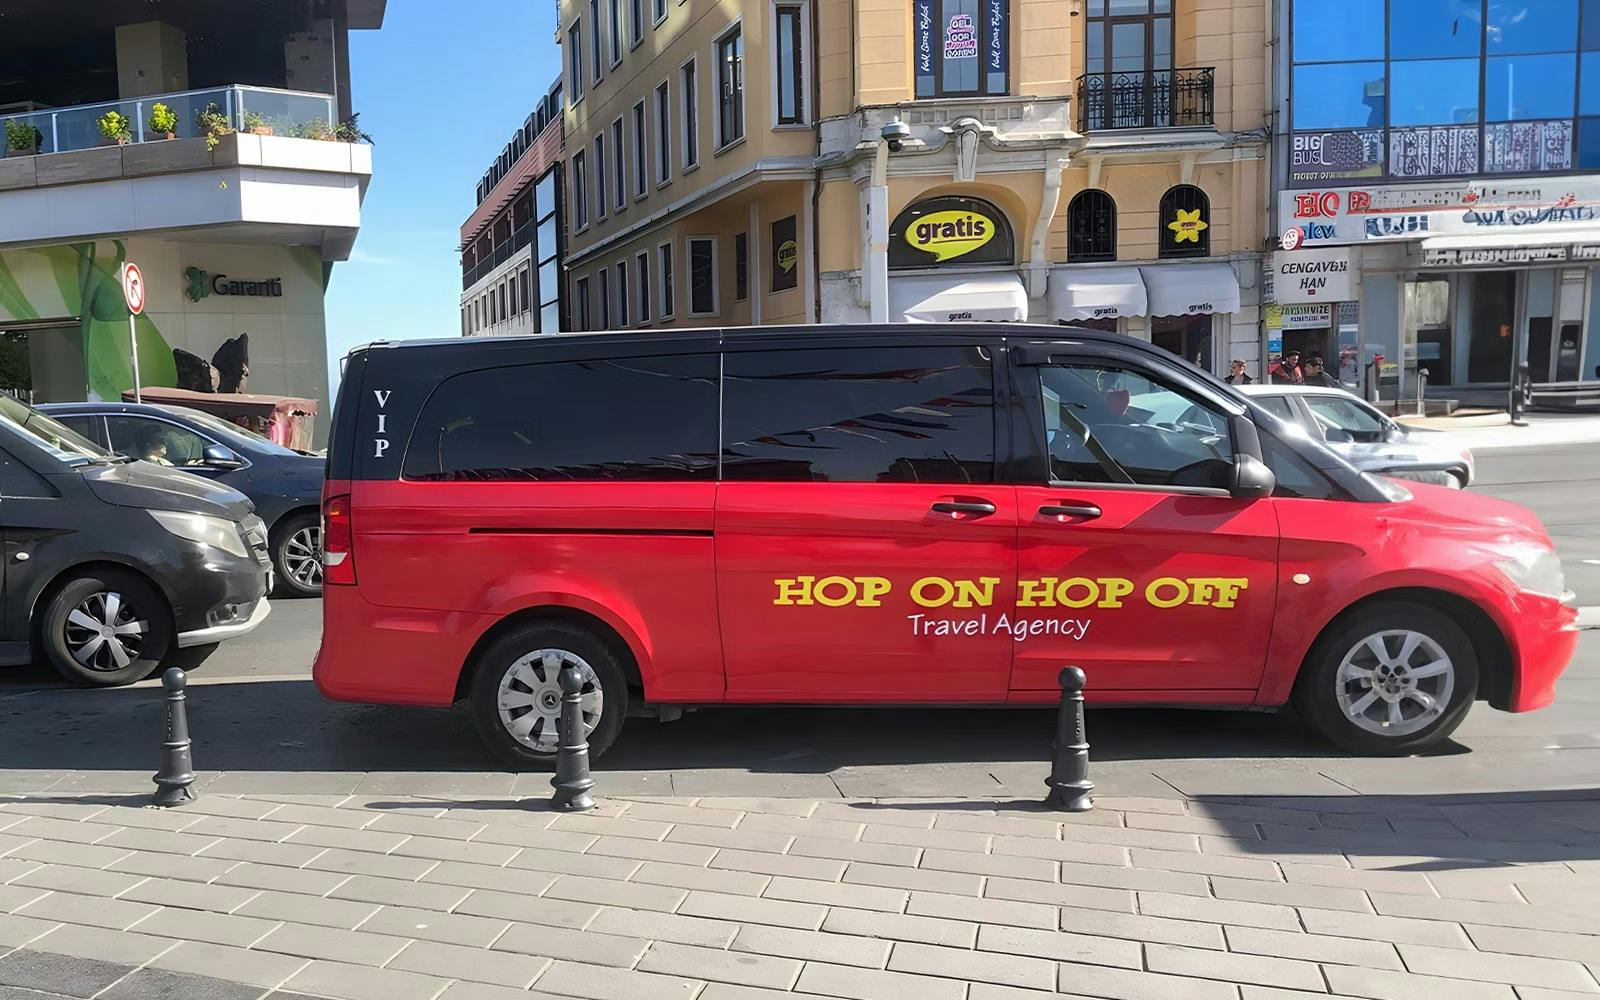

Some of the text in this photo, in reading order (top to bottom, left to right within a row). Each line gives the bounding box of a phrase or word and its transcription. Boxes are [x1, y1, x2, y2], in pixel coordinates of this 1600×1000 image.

[1294, 136, 1320, 150] BIG
[1294, 151, 1320, 165] BUS
[916, 215, 986, 245] gratis
[1300, 277, 1326, 289] HAN
[1094, 307, 1118, 317] gratis
[1189, 302, 1213, 312] gratis
[949, 311, 972, 322] gratis
[373, 390, 392, 457] VIP
[773, 575, 1248, 608] HOP ON HOP OFF
[907, 613, 1091, 641] Travel Agency
